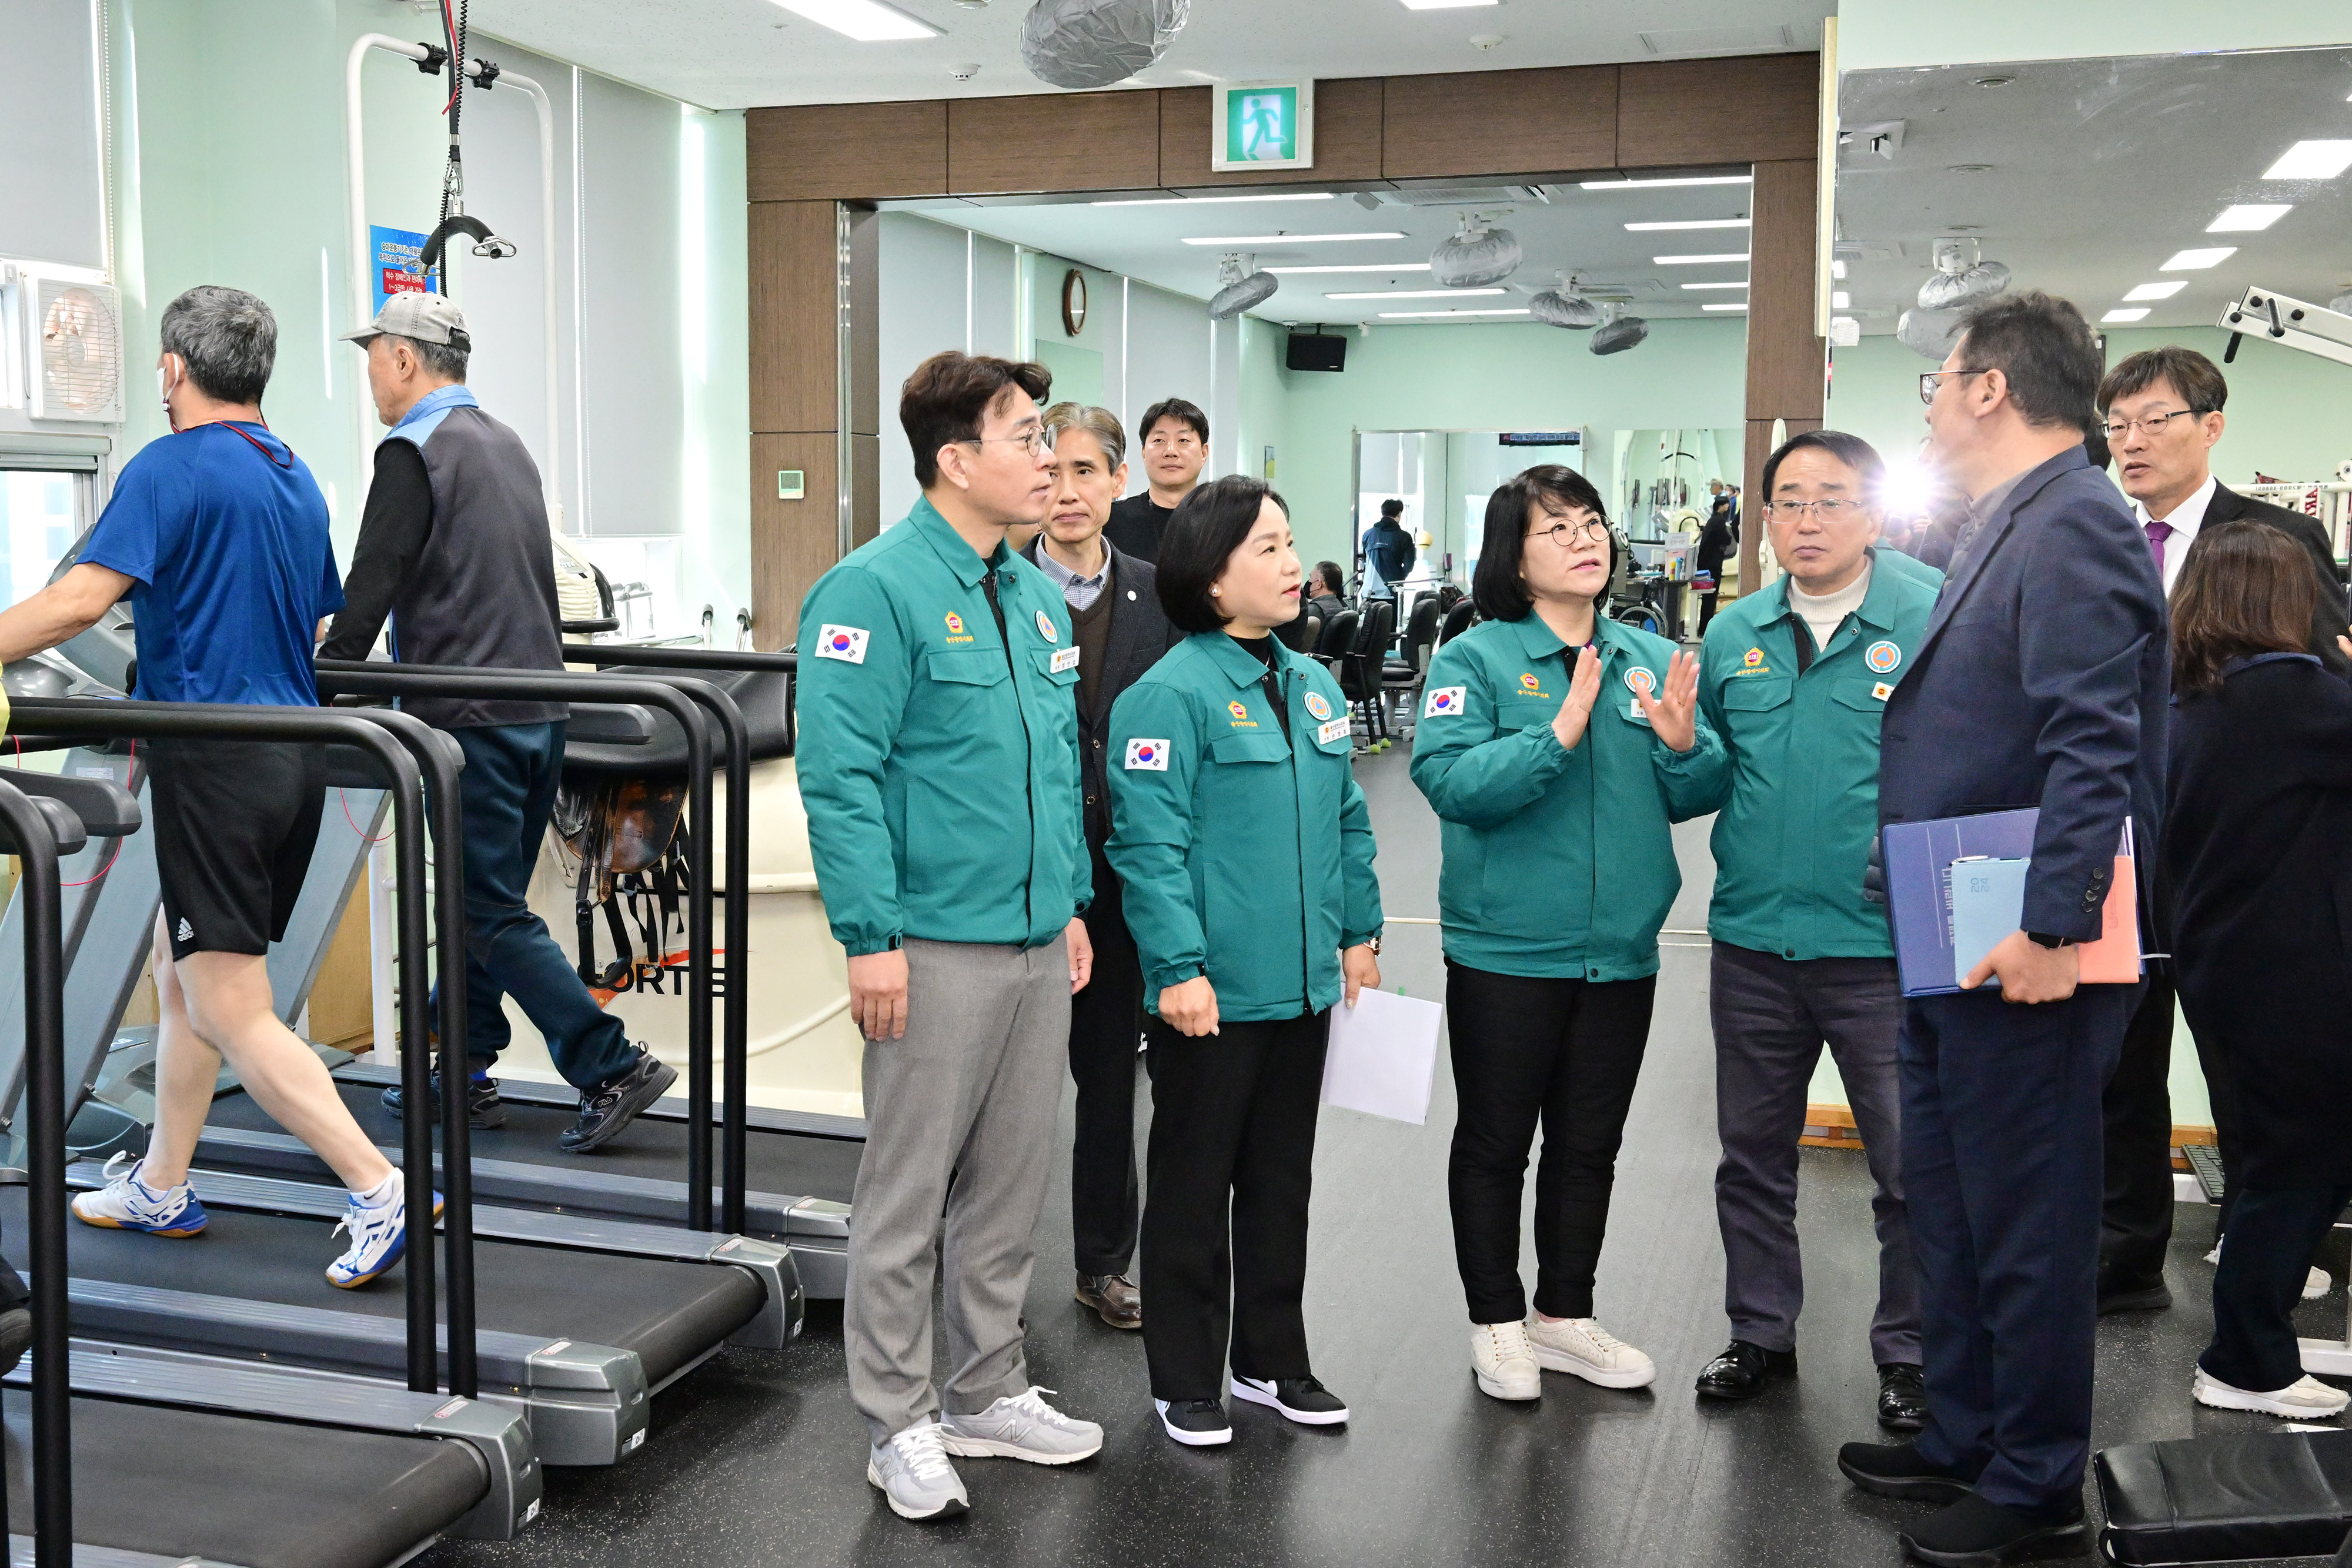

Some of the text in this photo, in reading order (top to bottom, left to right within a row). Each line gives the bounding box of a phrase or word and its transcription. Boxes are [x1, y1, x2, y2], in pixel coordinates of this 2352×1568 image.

[410, 247, 423, 256] 재활운
[379, 253, 395, 262] 목적으로
[386, 271, 394, 280] 척수
[395, 272, 411, 282] 장애인과
[597, 1096, 613, 1107] FILA
